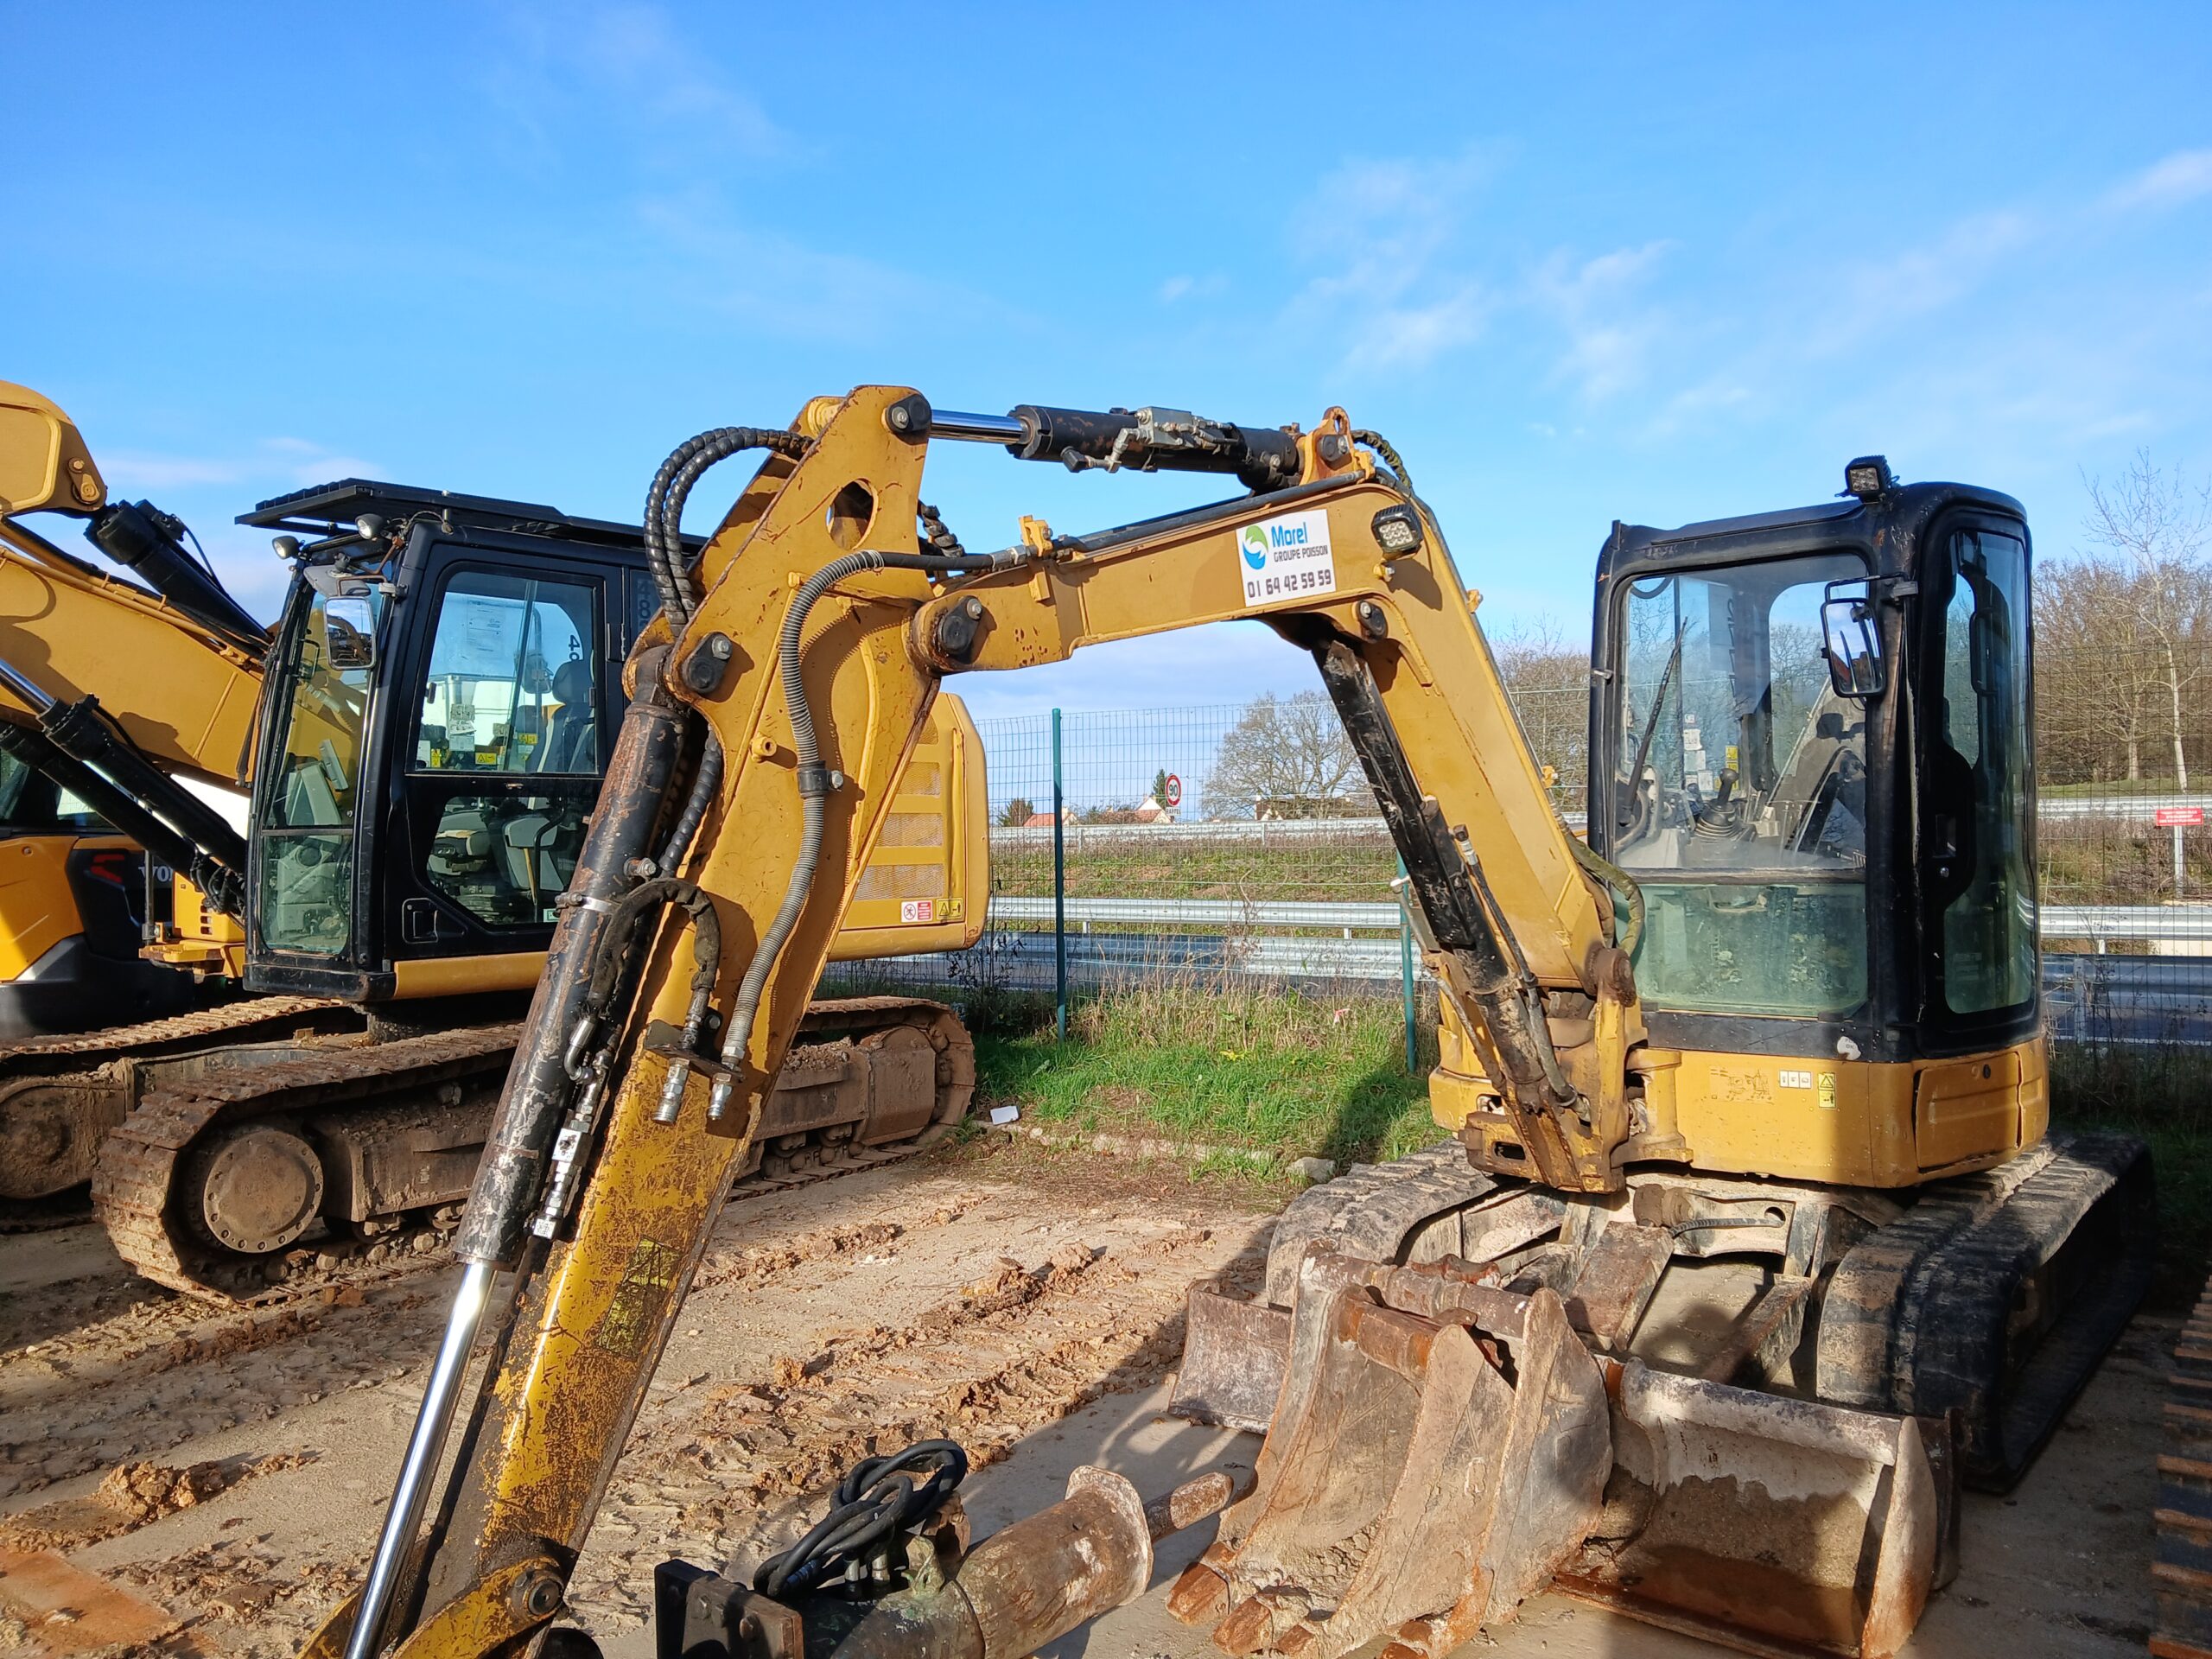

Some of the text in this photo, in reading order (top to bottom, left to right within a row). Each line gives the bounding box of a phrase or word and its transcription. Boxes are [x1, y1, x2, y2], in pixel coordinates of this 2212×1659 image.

[1271, 522, 1308, 547] Morel
[1274, 545, 1328, 563] GROUPE POISSON
[1248, 569, 1332, 598] 01 64 42 59 59
[1169, 784, 1179, 797] 90
